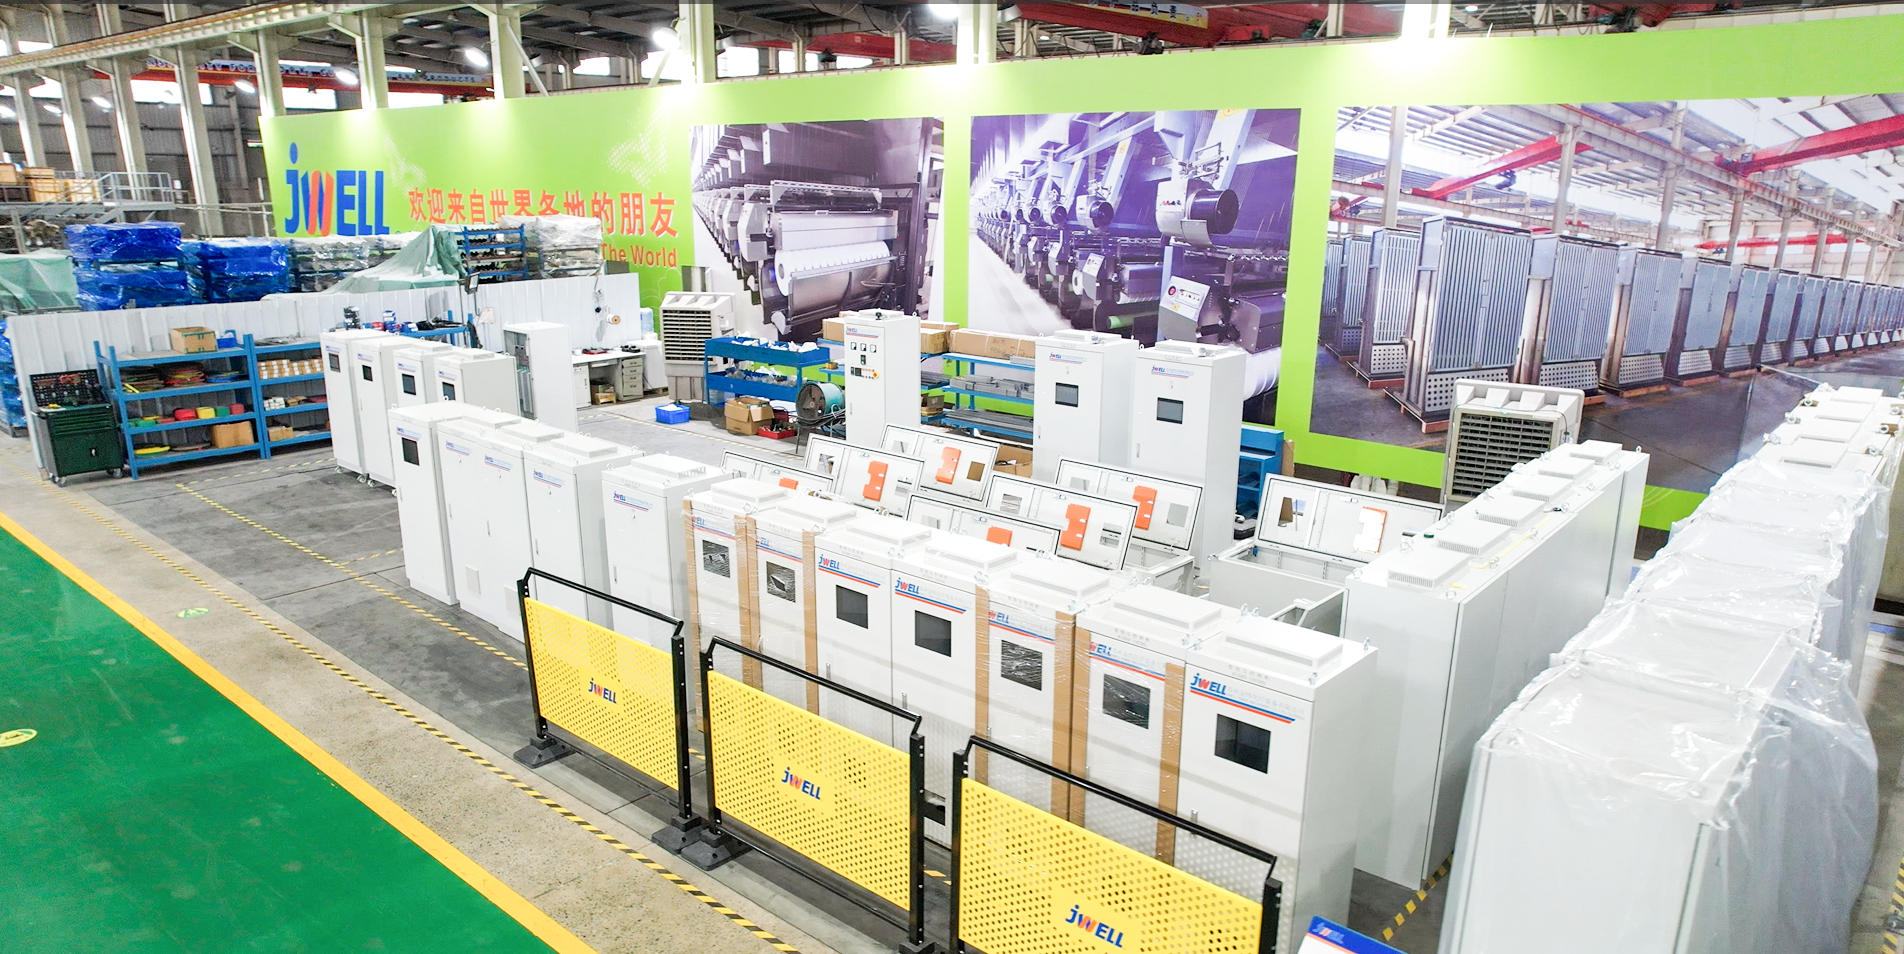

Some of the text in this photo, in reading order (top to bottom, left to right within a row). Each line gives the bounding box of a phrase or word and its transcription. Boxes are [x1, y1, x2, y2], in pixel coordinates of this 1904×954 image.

[408, 187, 678, 237] 欢迎来自世界各地的朋友
[601, 243, 678, 268] The World
